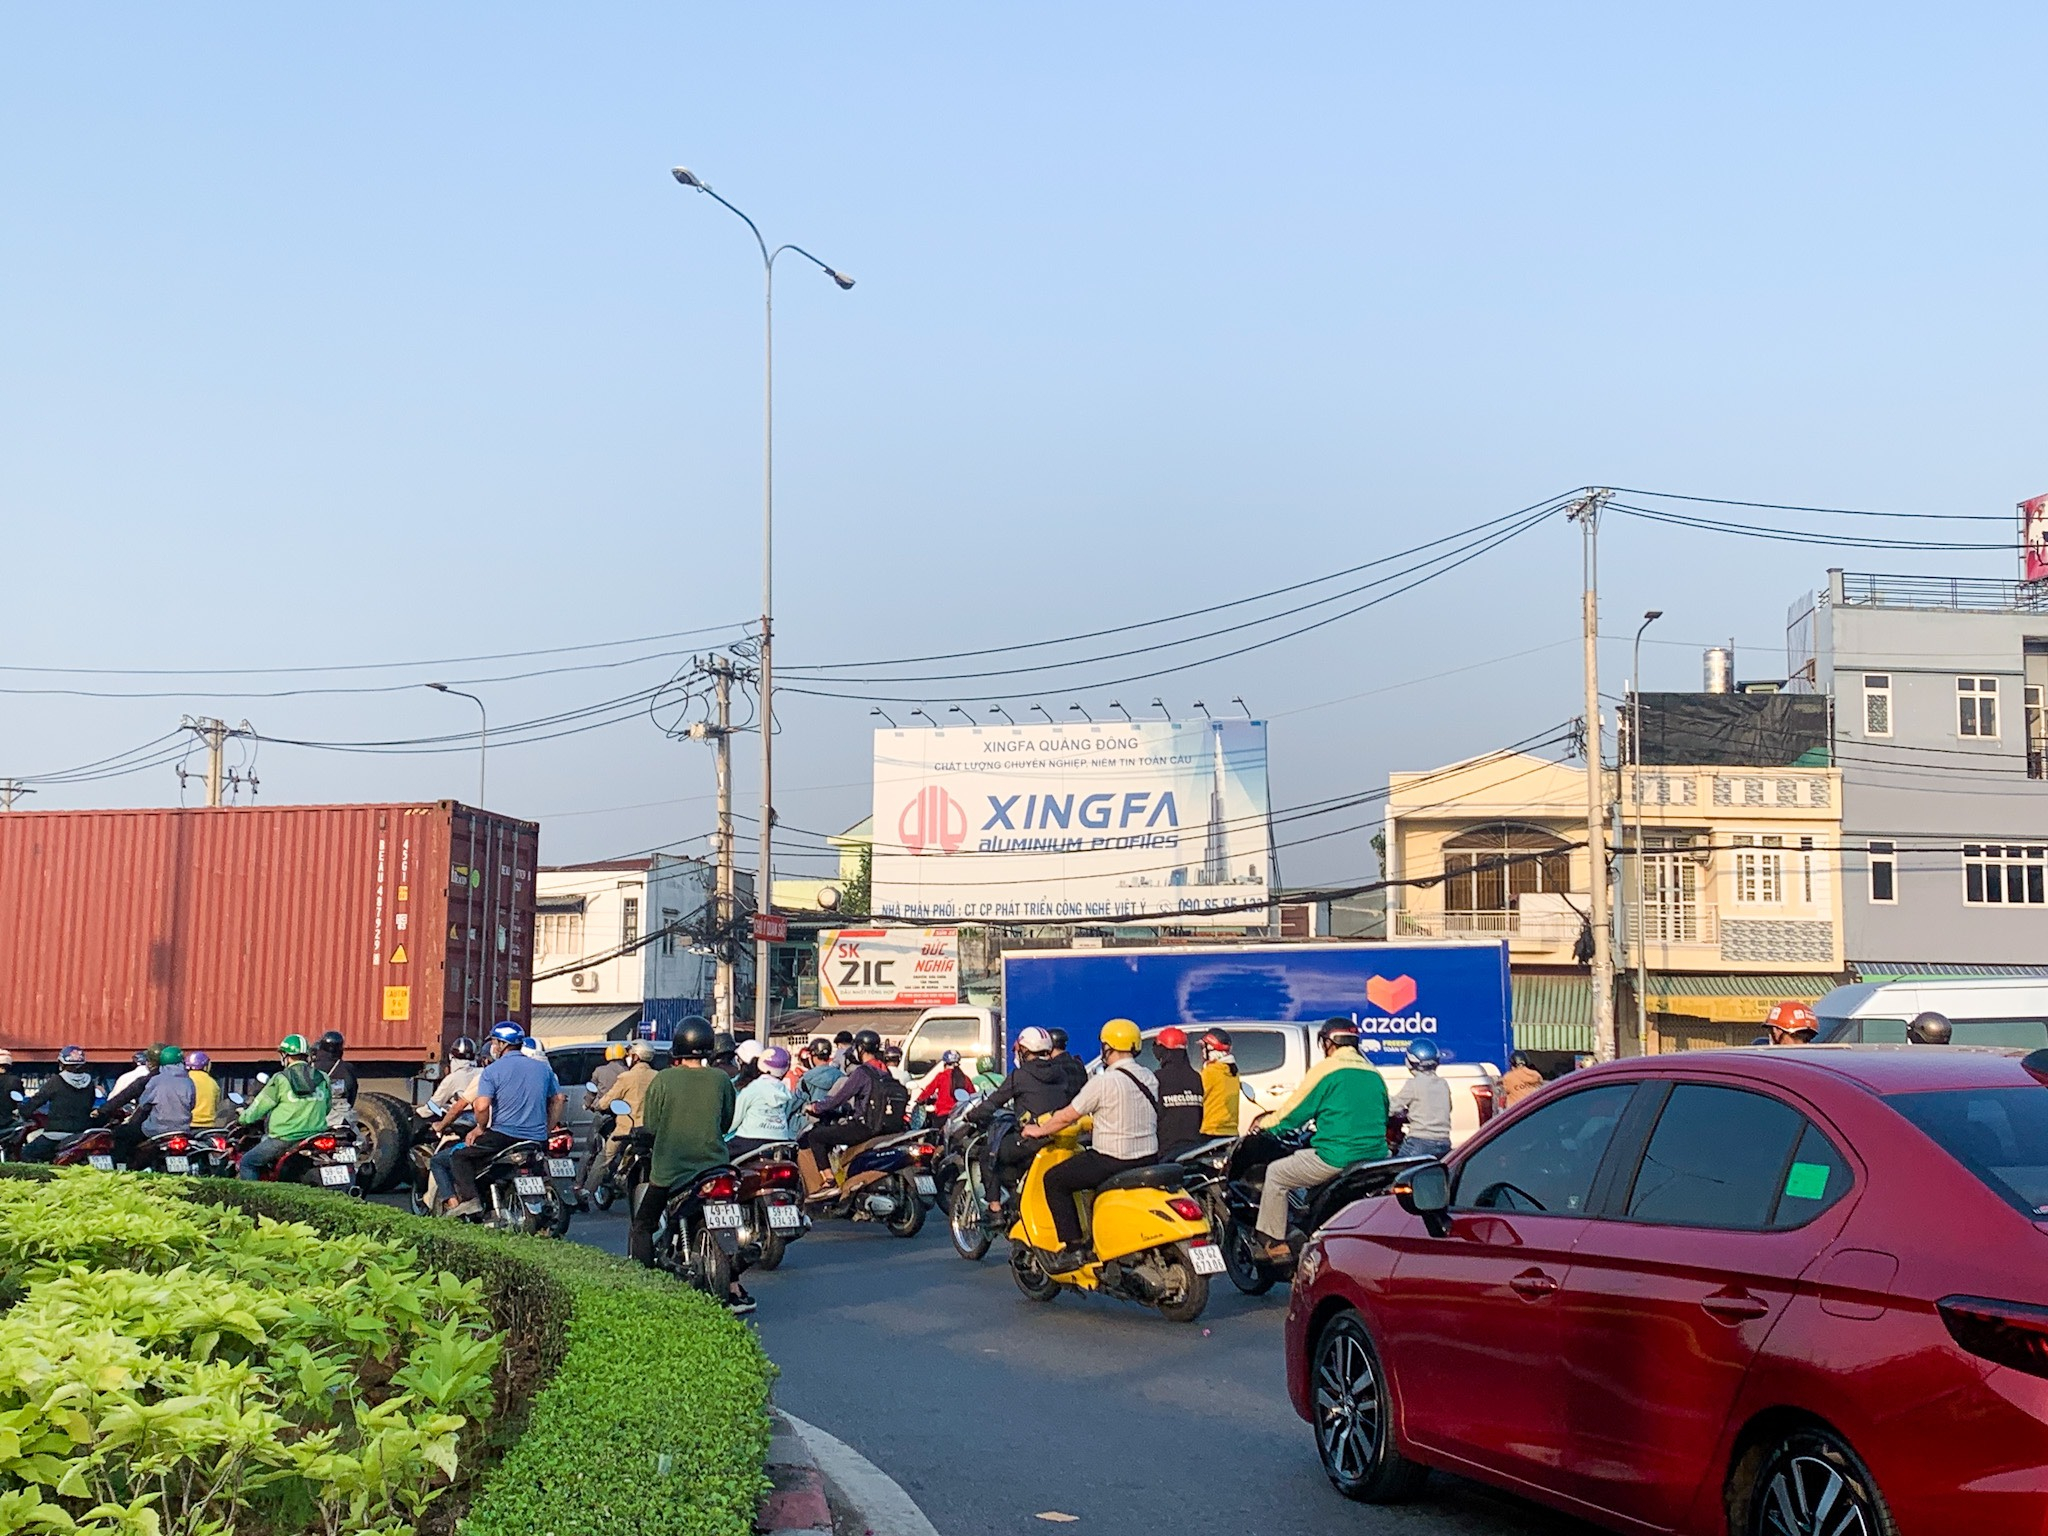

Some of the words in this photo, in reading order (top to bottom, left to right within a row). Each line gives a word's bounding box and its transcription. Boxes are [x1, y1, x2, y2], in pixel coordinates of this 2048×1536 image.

[983, 740, 1035, 753] XINGFA
[1039, 736, 1091, 752] QUẢNG
[1096, 735, 1138, 750] ĐÔNG
[964, 760, 1001, 771] LƯỢNG
[1120, 758, 1135, 767] TIN
[1139, 755, 1167, 766] TOÀN
[980, 791, 1179, 831] XINGFA
[882, 900, 900, 917] NHÀ
[904, 900, 930, 917] PHÂN
[933, 898, 955, 917] PHỐI
[964, 903, 976, 916] CT
[980, 903, 992, 916] CP
[996, 899, 1020, 916] PHÁT
[1023, 895, 1052, 916] TRIỂN
[1056, 898, 1082, 916] CÔNG
[1140, 898, 1146, 915] Ý
[1178, 898, 1200, 912] 090
[838, 943, 860, 958] SK
[921, 939, 948, 955] ĐỨC
[838, 960, 896, 986] ZIC
[915, 956, 955, 973] NGHĨA
[1351, 1011, 1437, 1034] Lazada
